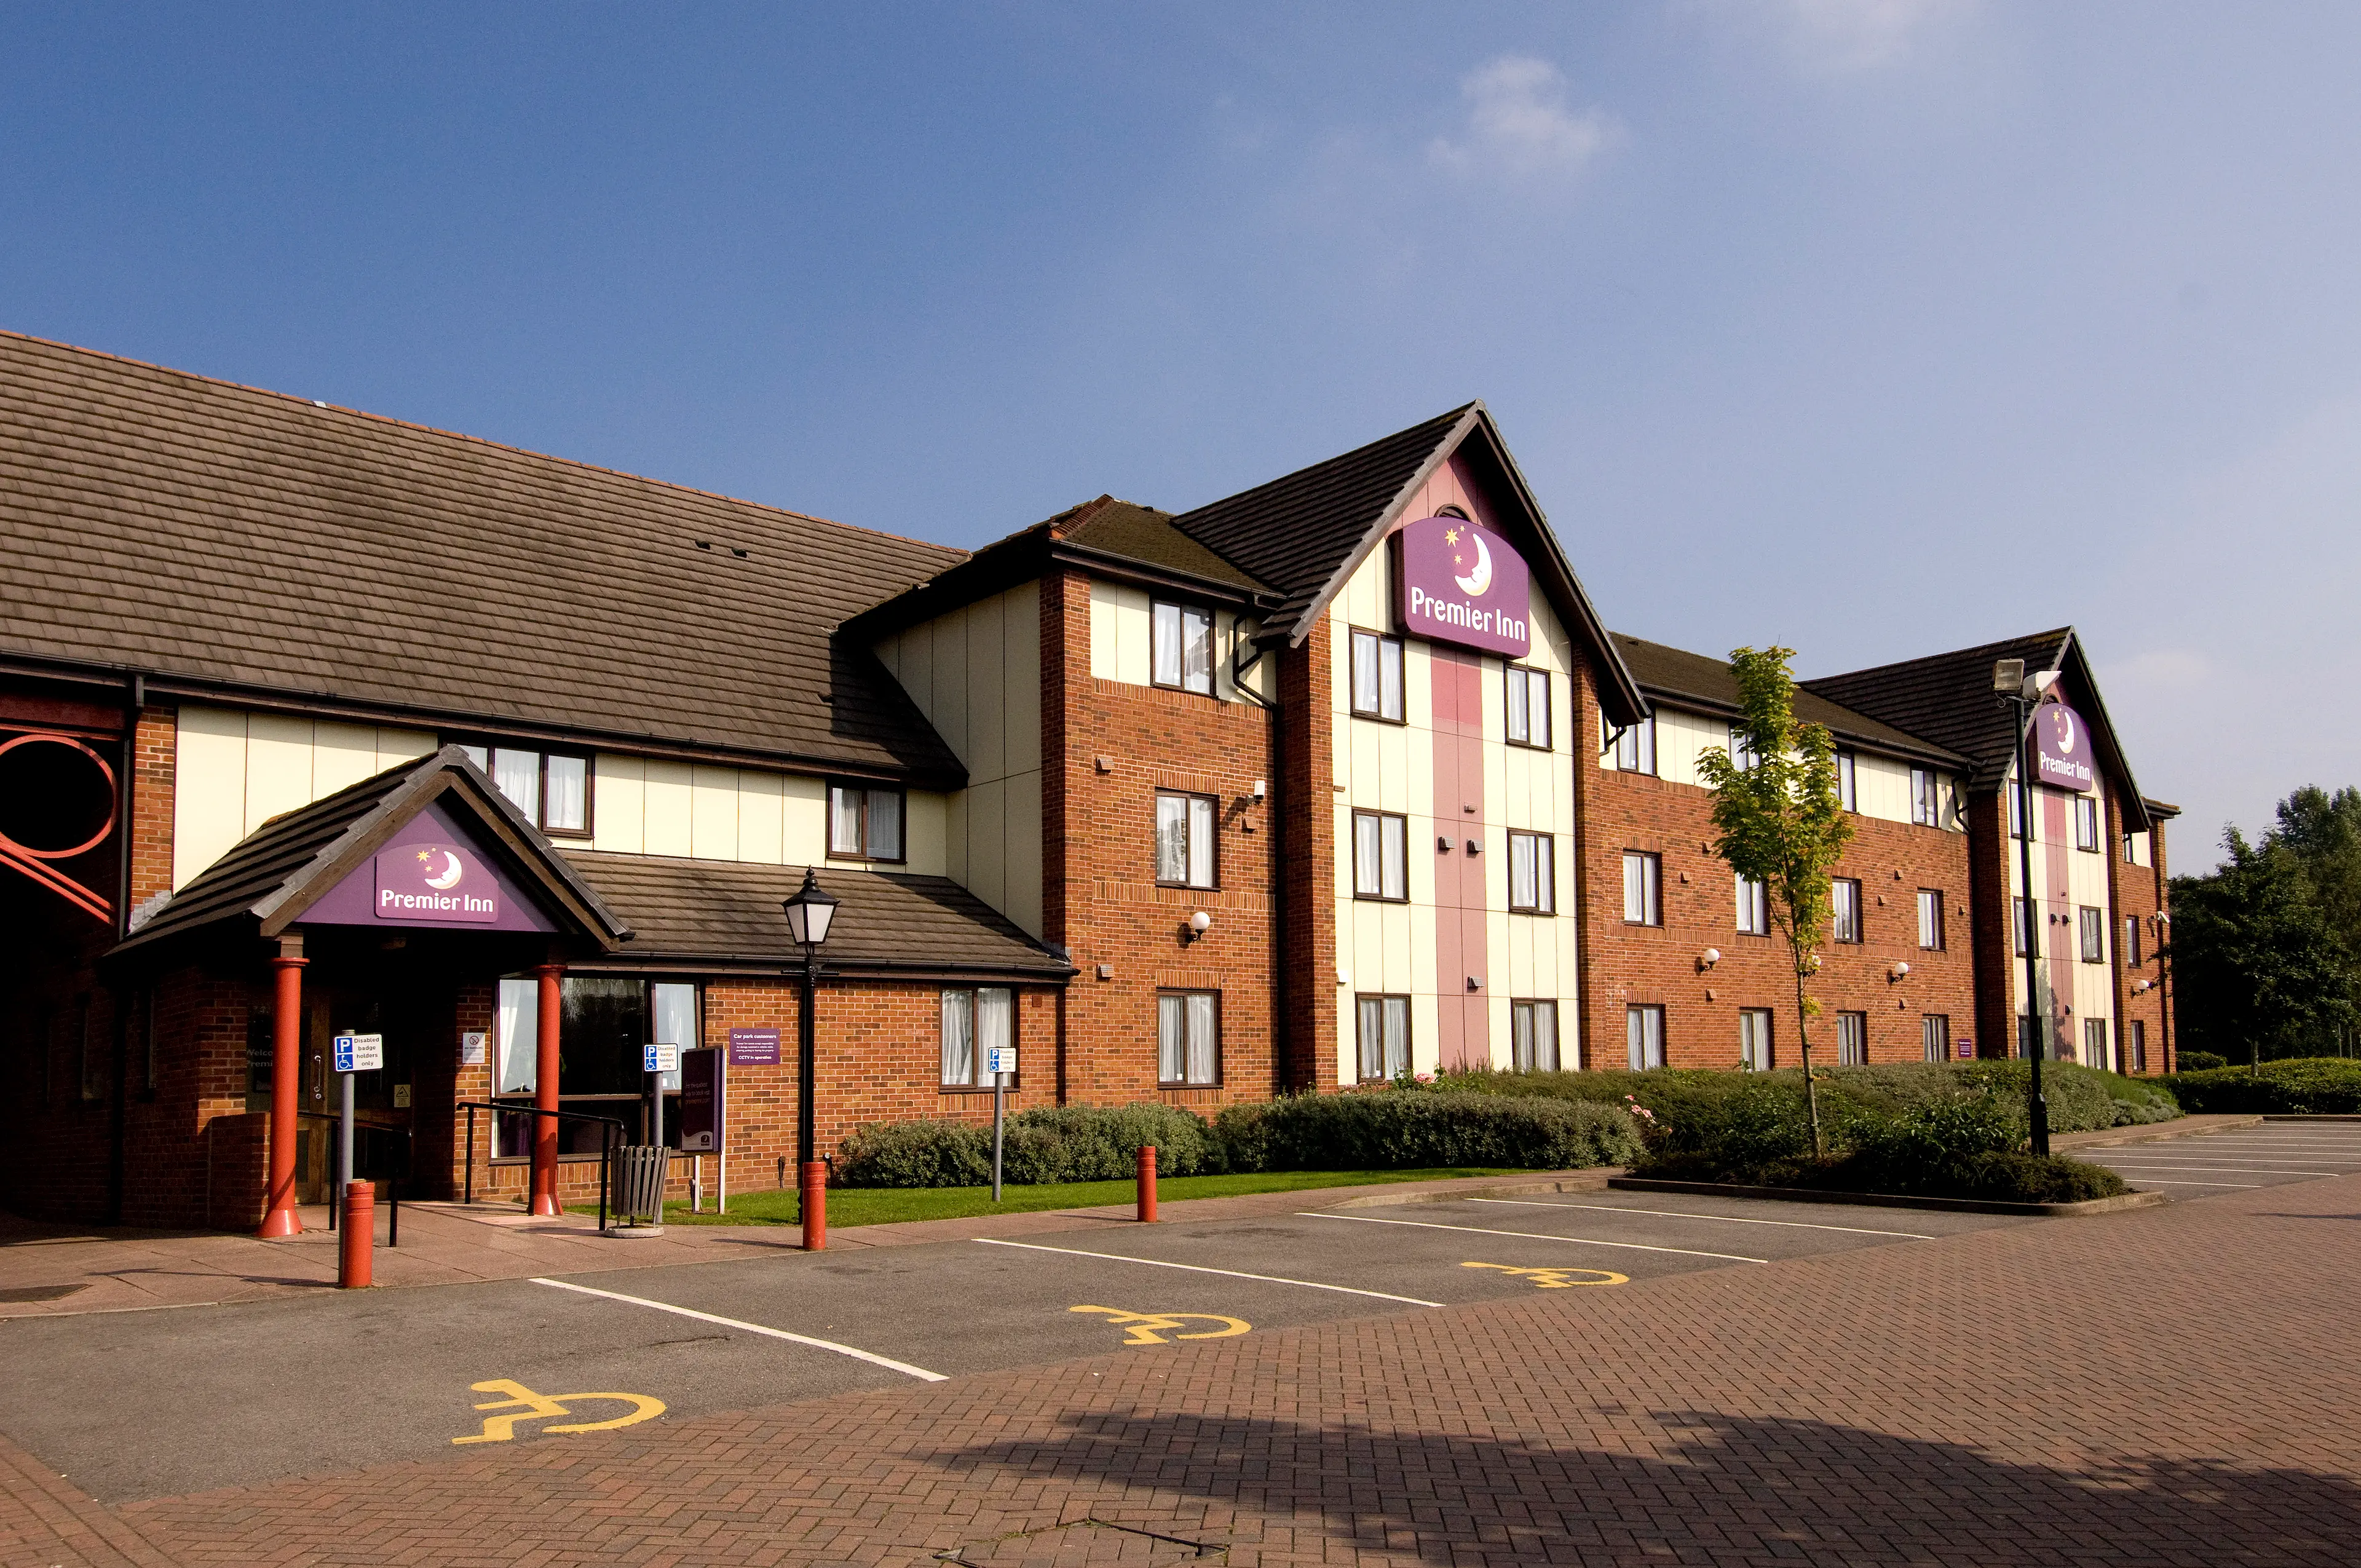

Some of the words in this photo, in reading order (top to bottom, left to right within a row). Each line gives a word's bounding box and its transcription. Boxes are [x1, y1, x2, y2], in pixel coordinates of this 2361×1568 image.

[1411, 586, 1492, 632] Premier
[1496, 609, 1525, 641] Inn
[2040, 751, 2076, 777] Premier
[2076, 761, 2090, 781] Inn
[381, 889, 461, 910] Premier
[464, 894, 493, 913] Inn
[341, 1039, 350, 1052] P
[648, 1047, 655, 1057] P
[992, 1050, 999, 1059] P
